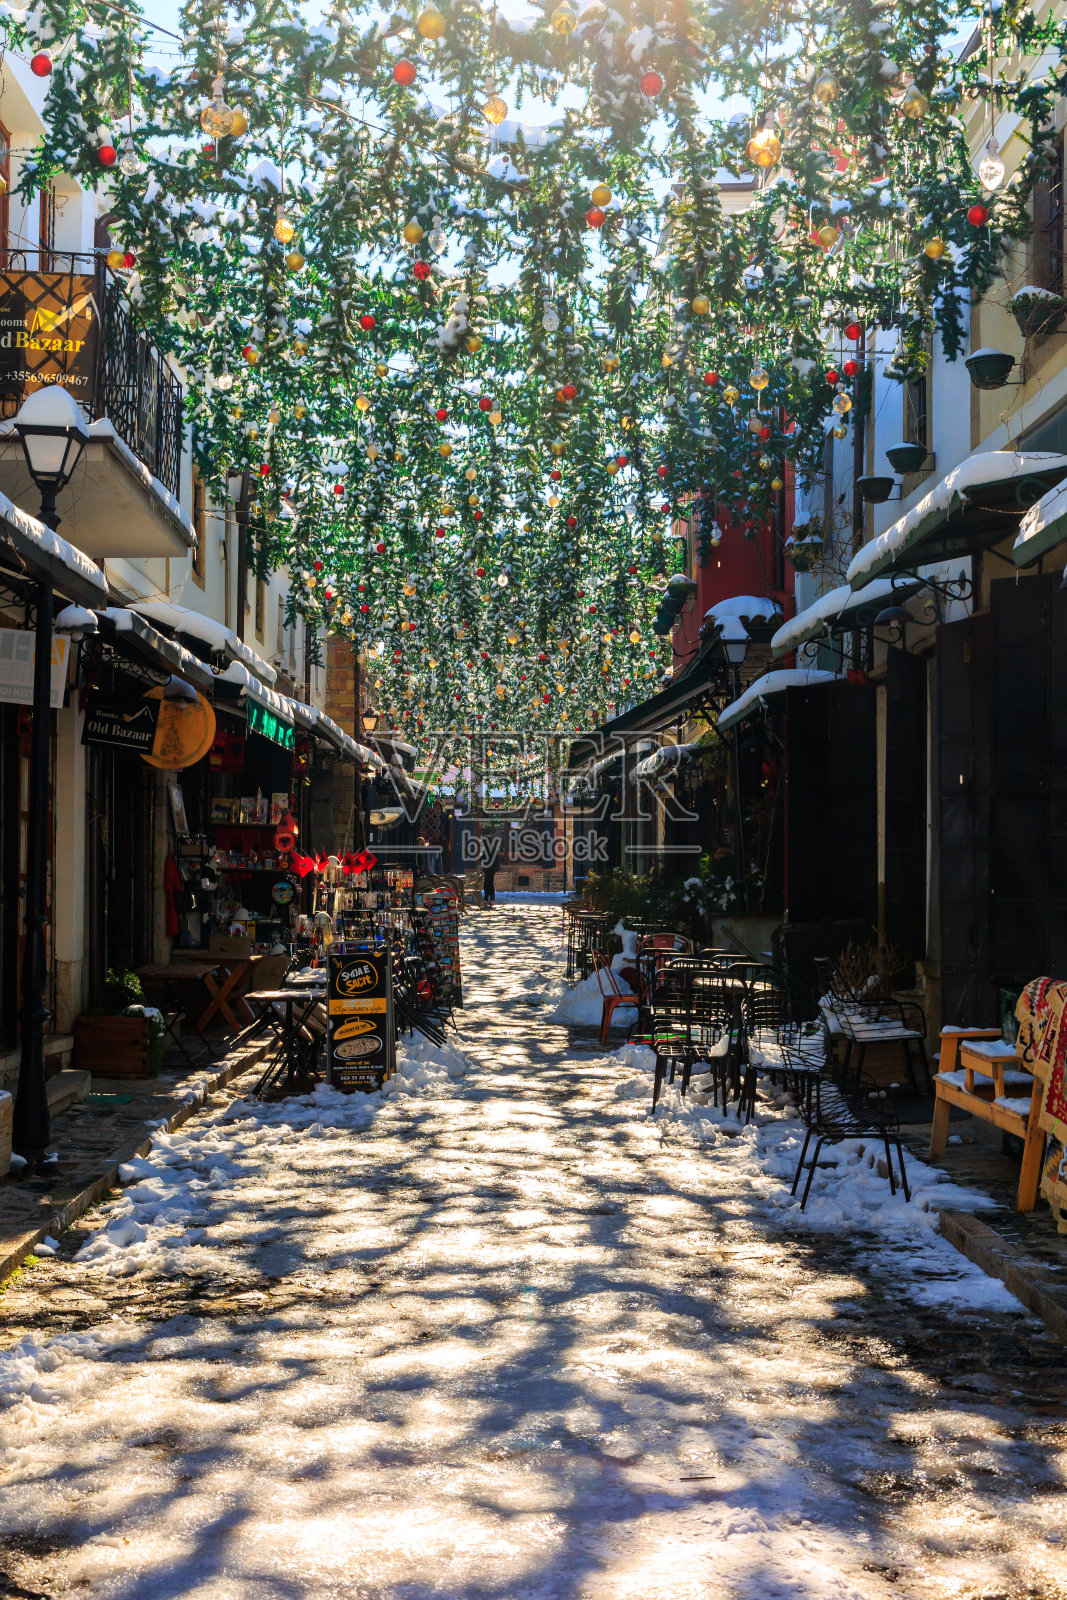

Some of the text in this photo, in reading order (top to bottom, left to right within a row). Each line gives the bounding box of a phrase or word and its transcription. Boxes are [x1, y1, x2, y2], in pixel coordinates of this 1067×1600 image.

[15, 331, 86, 353] Bazaar
[87, 720, 153, 742] Old Bazaar
